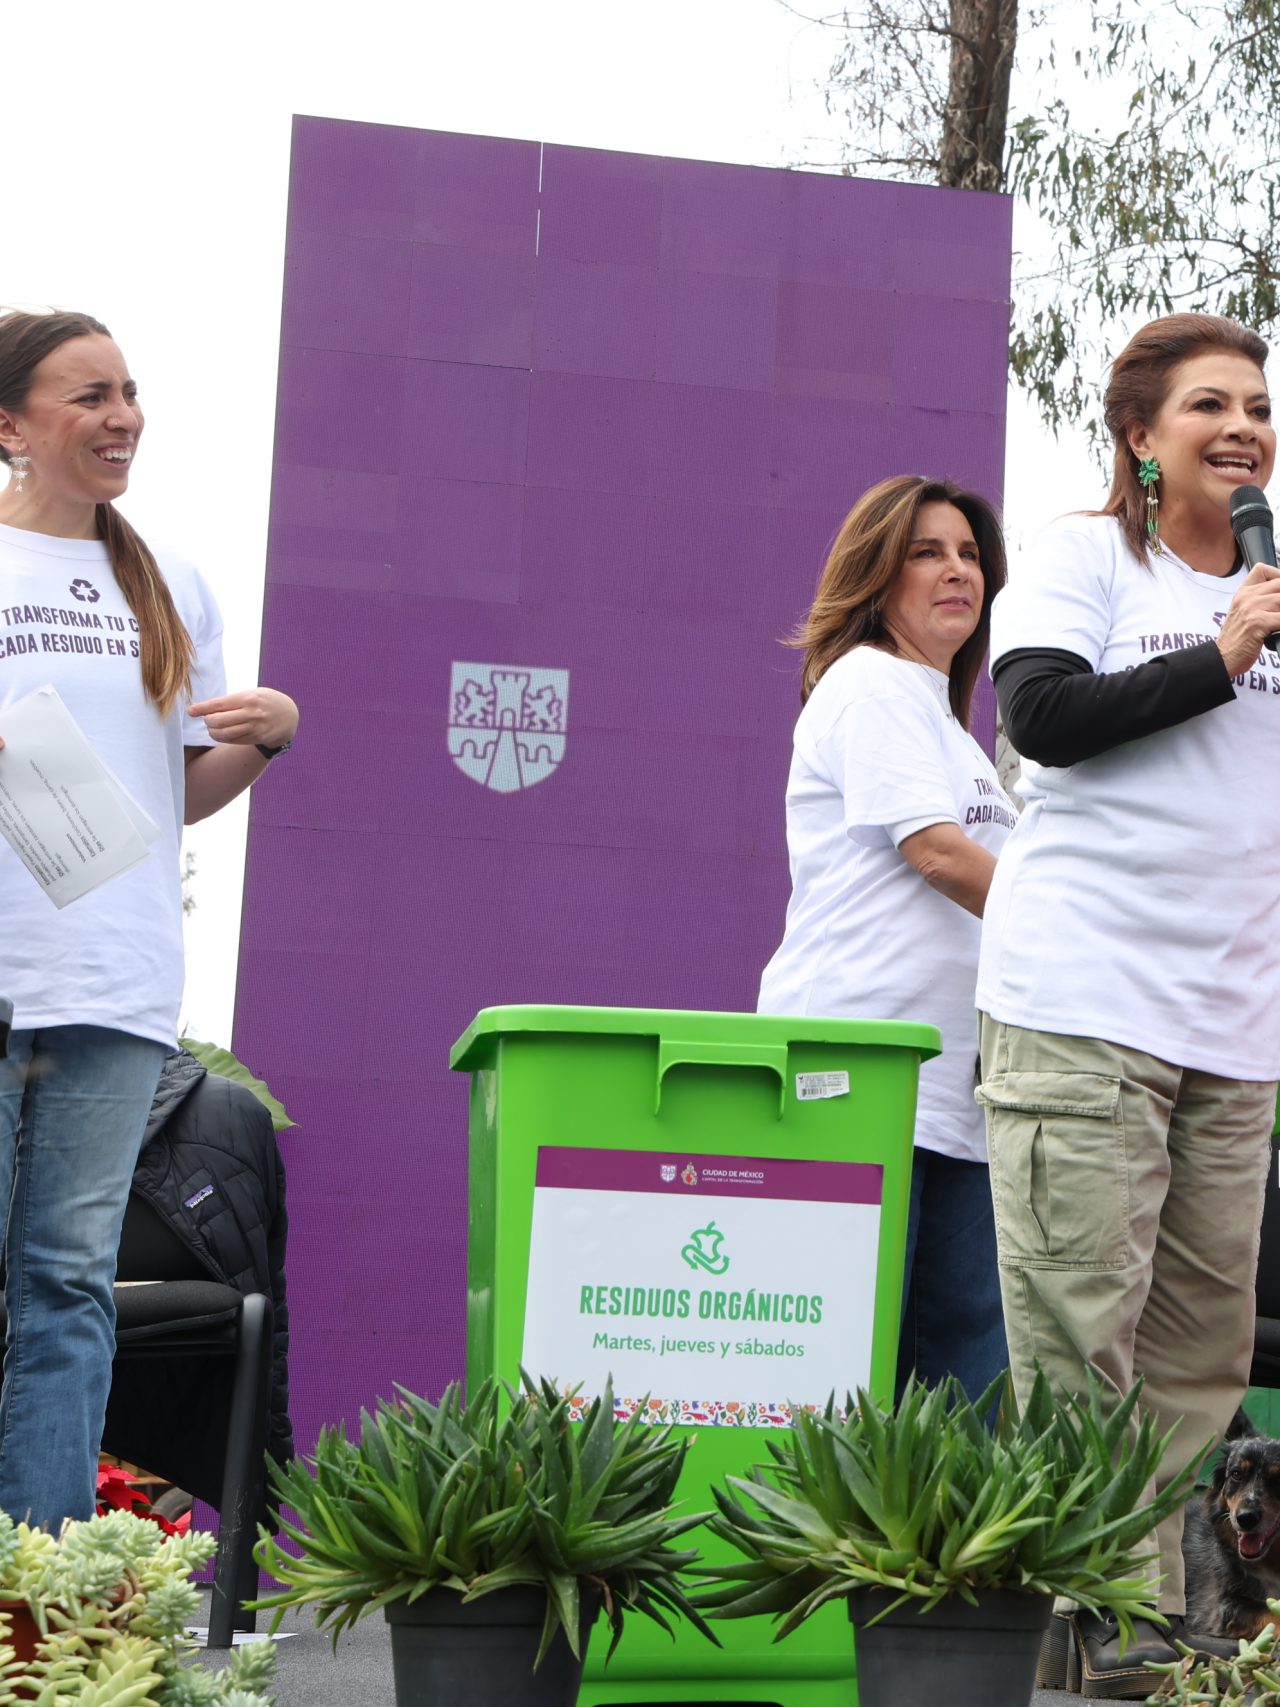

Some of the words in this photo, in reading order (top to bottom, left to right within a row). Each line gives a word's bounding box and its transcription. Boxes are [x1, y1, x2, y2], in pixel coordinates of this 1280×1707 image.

[2, 605, 103, 629] TRANSFORMA
[104, 615, 125, 632] TU
[41, 633, 103, 655] RESIDUO
[106, 638, 126, 656] EN
[130, 640, 142, 658] S
[1250, 670, 1267, 692] EN
[965, 804, 992, 825] CADA
[702, 1169, 727, 1177] CIUDAD
[739, 1170, 764, 1178] MÉXICO
[580, 1285, 690, 1319] RESIDUOS
[699, 1288, 823, 1324] ORGÁNICOS
[592, 1333, 656, 1354] Martes,
[660, 1335, 715, 1356] jueves
[720, 1341, 731, 1358] y
[734, 1338, 805, 1357] sábados
